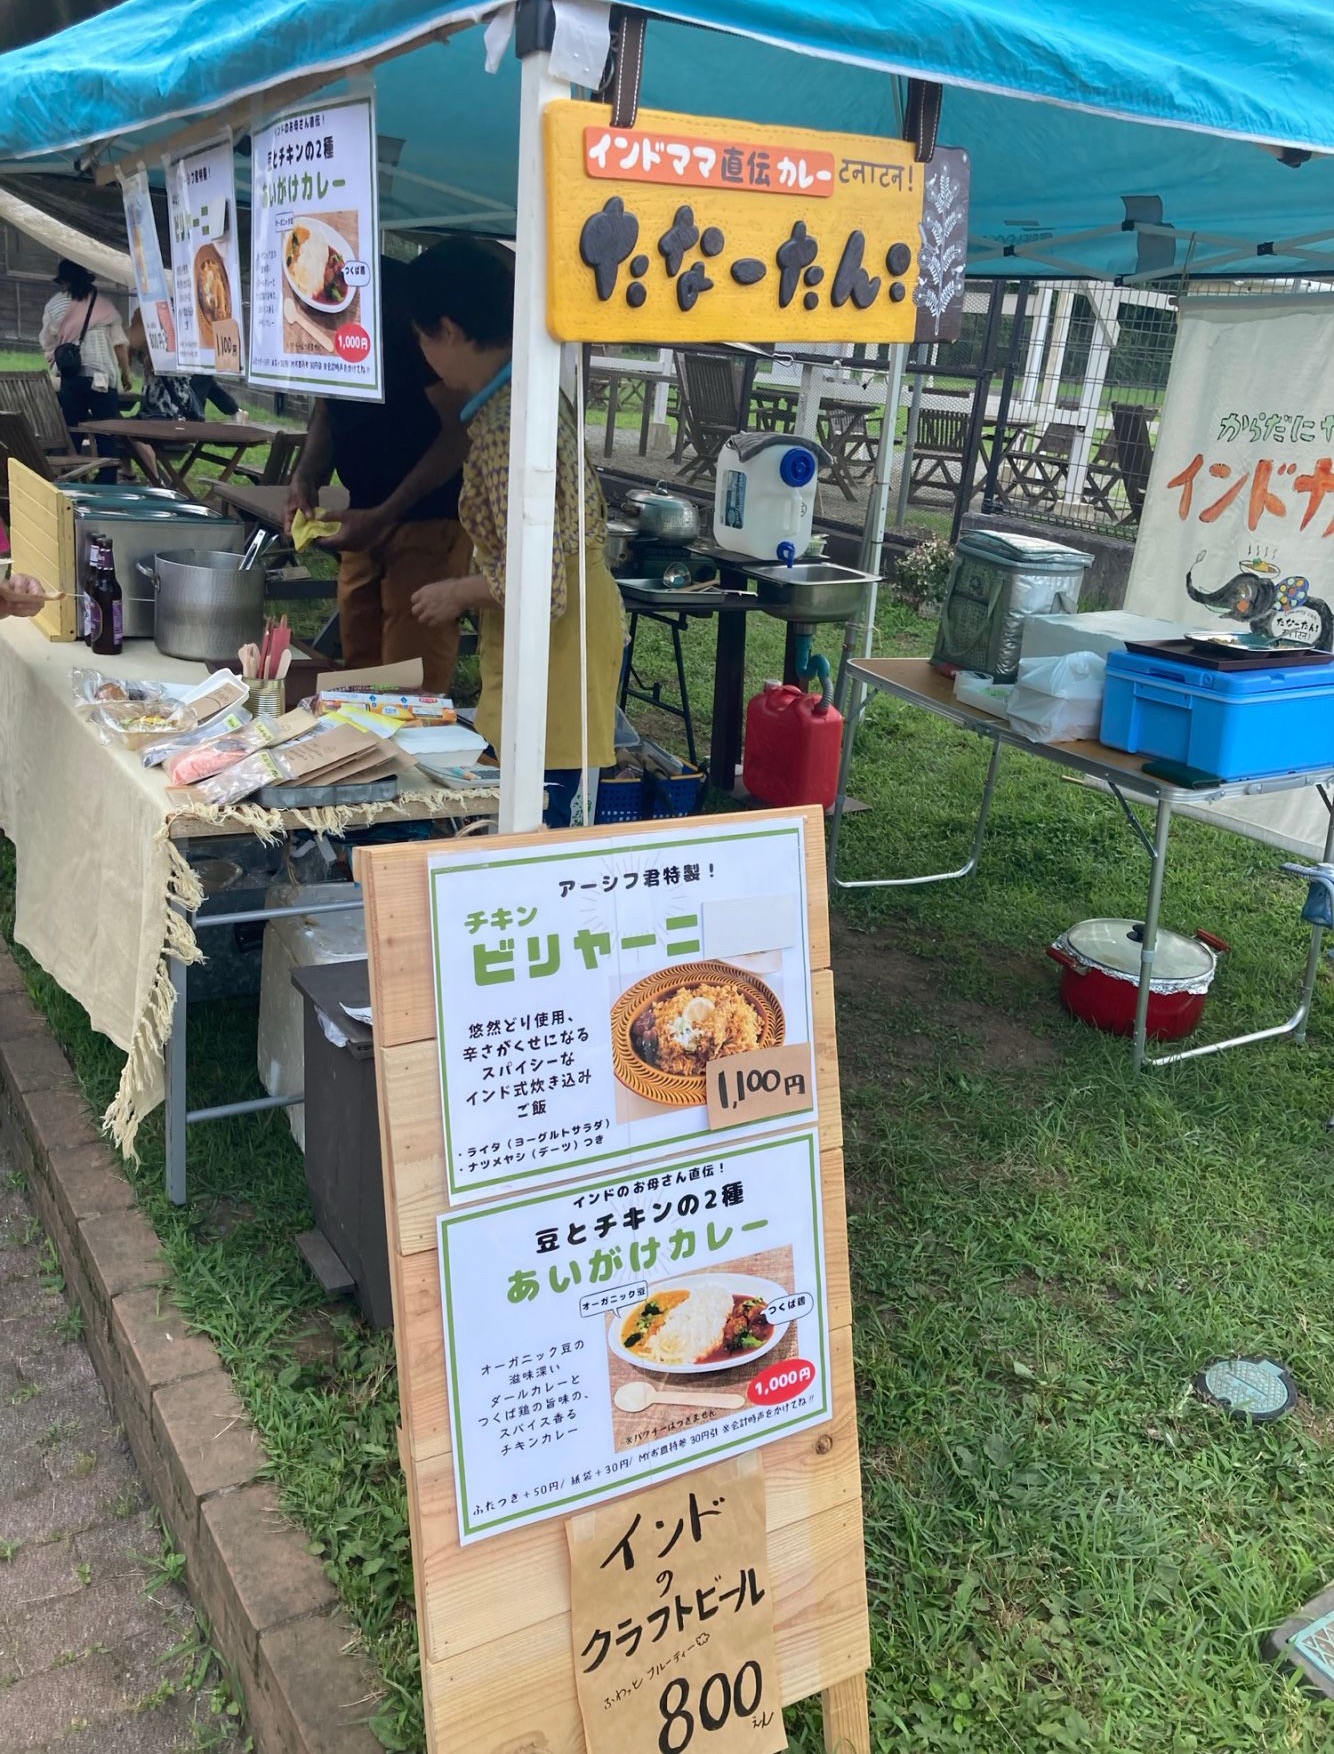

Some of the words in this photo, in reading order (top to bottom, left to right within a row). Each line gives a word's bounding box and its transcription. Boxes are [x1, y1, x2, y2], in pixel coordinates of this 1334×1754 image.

[588, 133, 832, 189] インドママ直伝カレー
[338, 335, 368, 350] 1,000円
[559, 863, 715, 898] アーシフ君特製！
[464, 906, 538, 934] チキン
[473, 914, 700, 986] ビリヤーニ
[468, 1010, 574, 1039] 悠然どり使用、
[463, 1027, 589, 1062] 辛さがくせになる
[482, 1051, 575, 1080] スパイシーな
[466, 1069, 592, 1106] インド式炊き込み
[718, 1069, 805, 1109] 1,100円
[517, 1099, 547, 1118] ご飯
[573, 1162, 726, 1209] インドのお母さん直伝！
[535, 1181, 744, 1254] 豆とチキンの2種
[507, 1219, 769, 1303] あいがけカレー
[582, 1287, 646, 1311] オーガニック豆
[768, 1296, 806, 1315] つくば鶏
[481, 1339, 584, 1376] オーガニック豆の
[491, 1375, 580, 1409] ダールカレーと
[509, 1364, 560, 1386] 滋味深い
[755, 1366, 811, 1396] 1,000円
[500, 1408, 577, 1439] スパイス香る
[501, 1427, 578, 1456] チキンカレー
[600, 1492, 725, 1571] インド
[656, 1570, 674, 1598] の
[581, 1568, 765, 1674] クラフトビール
